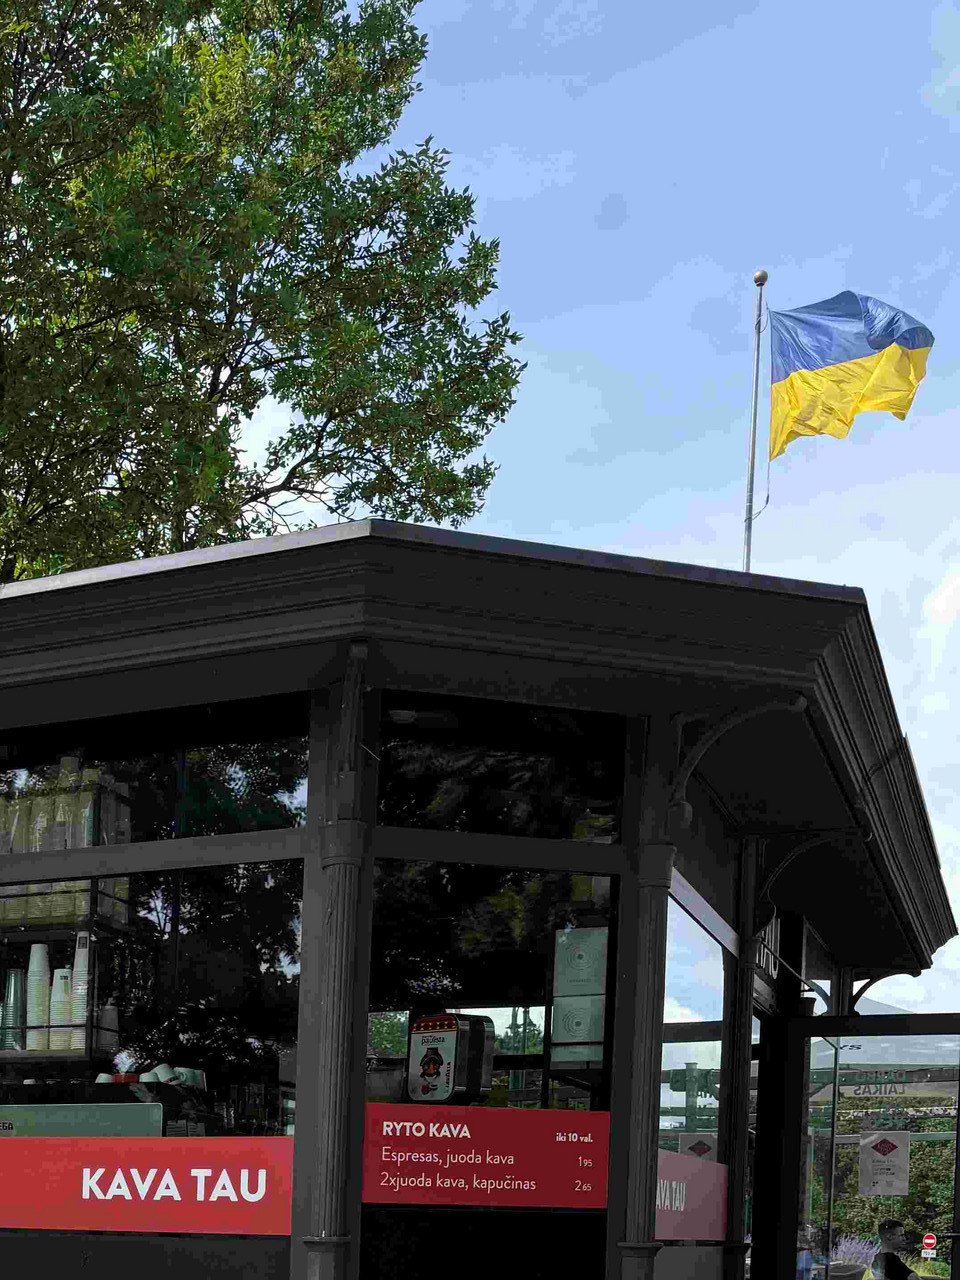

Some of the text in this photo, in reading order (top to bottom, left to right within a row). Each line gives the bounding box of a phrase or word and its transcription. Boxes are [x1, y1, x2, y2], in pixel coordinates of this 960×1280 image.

[382, 1121, 471, 1139] RYTO KAVA
[555, 1132, 594, 1143] iki 10 val.
[382, 1146, 515, 1169] Espresas, juoda kava
[82, 1167, 268, 1203] KAVA TAU
[380, 1171, 536, 1194] 2xjuoda kava, kapučinas
[655, 1179, 671, 1211] AVA
